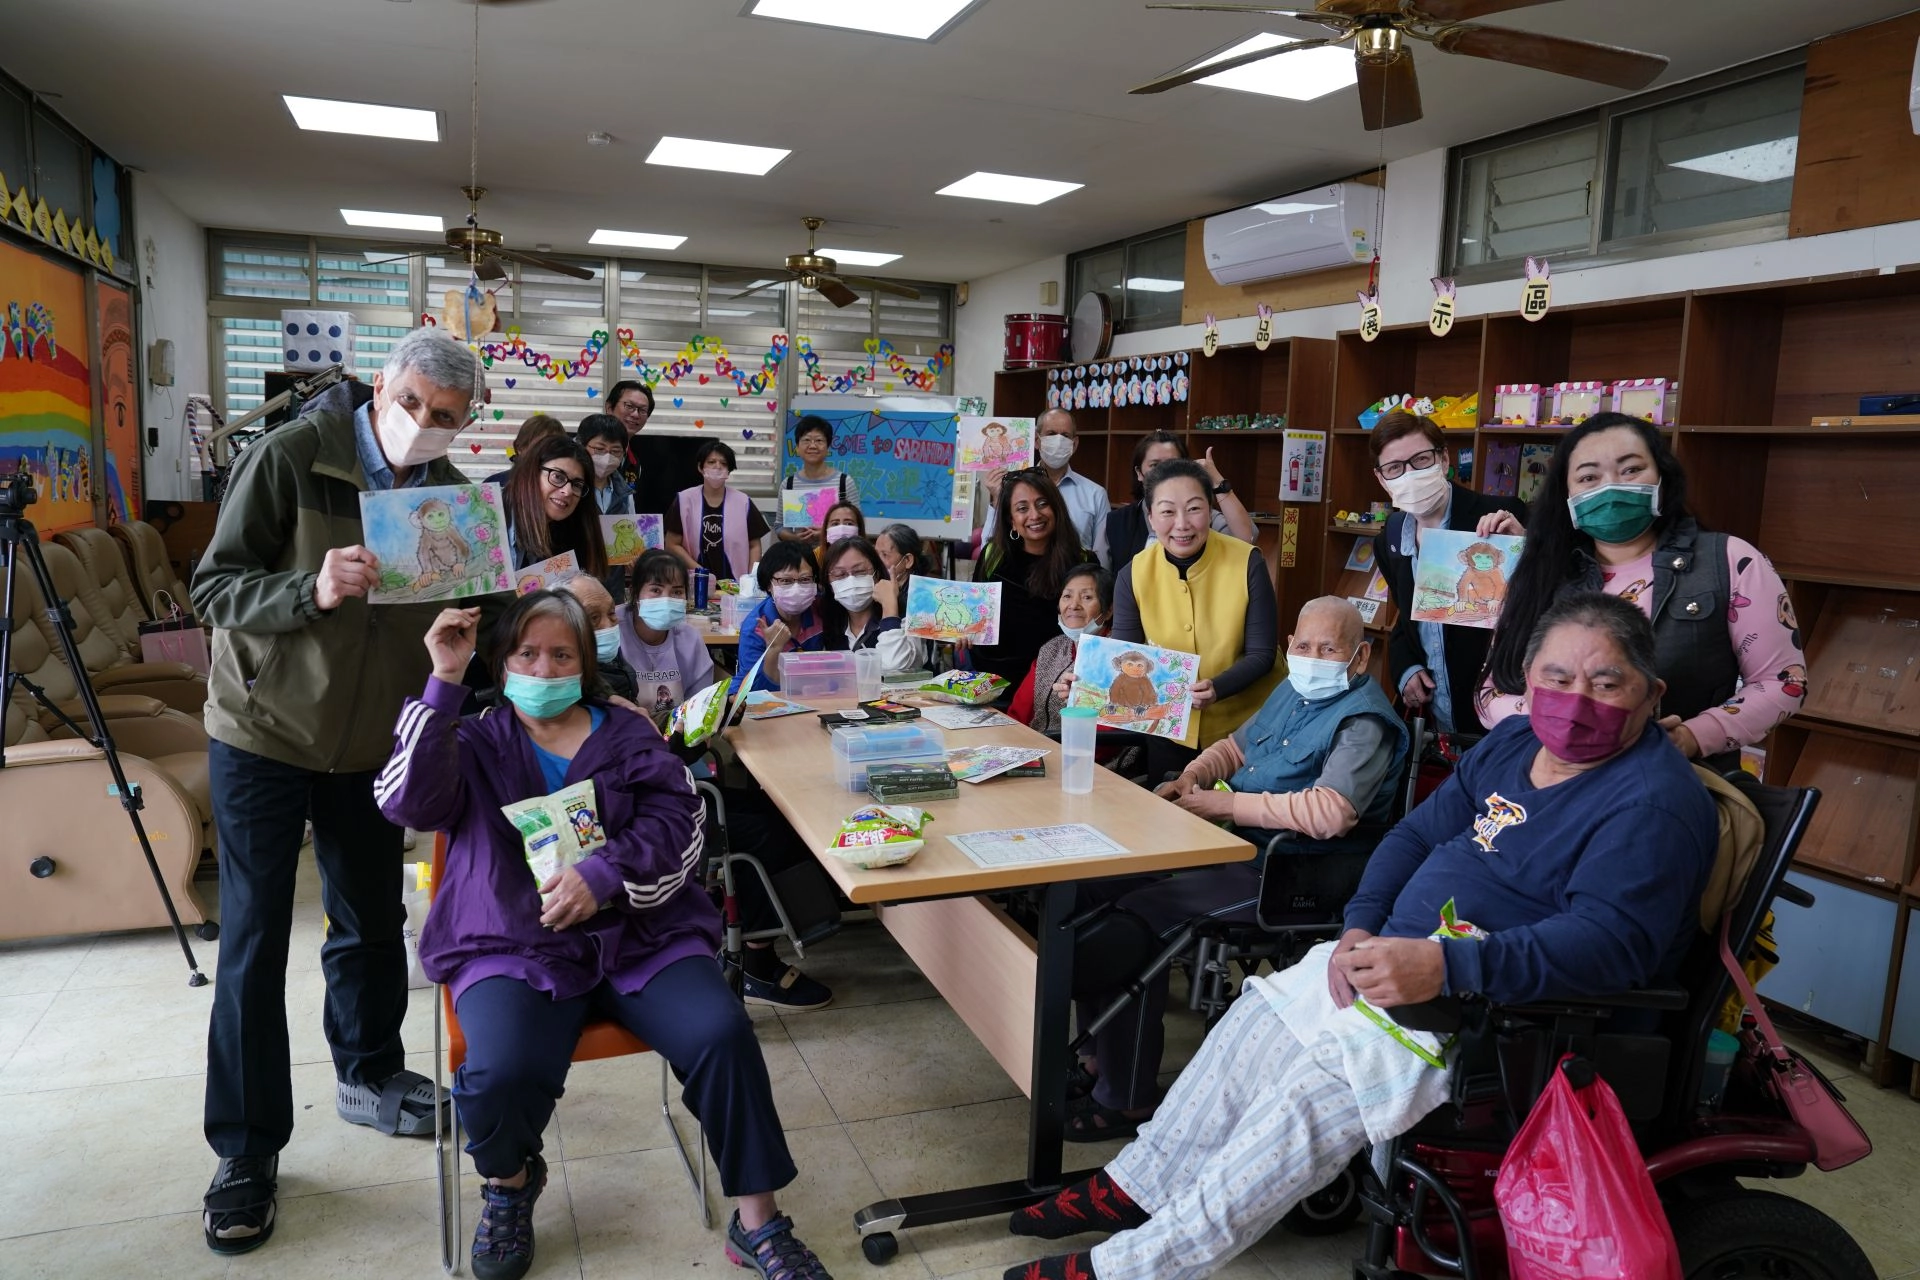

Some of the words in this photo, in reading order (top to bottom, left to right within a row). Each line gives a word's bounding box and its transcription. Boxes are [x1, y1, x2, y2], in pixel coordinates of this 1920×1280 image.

[872, 435, 893, 454] to
[1281, 509, 1298, 567] 滅火器
